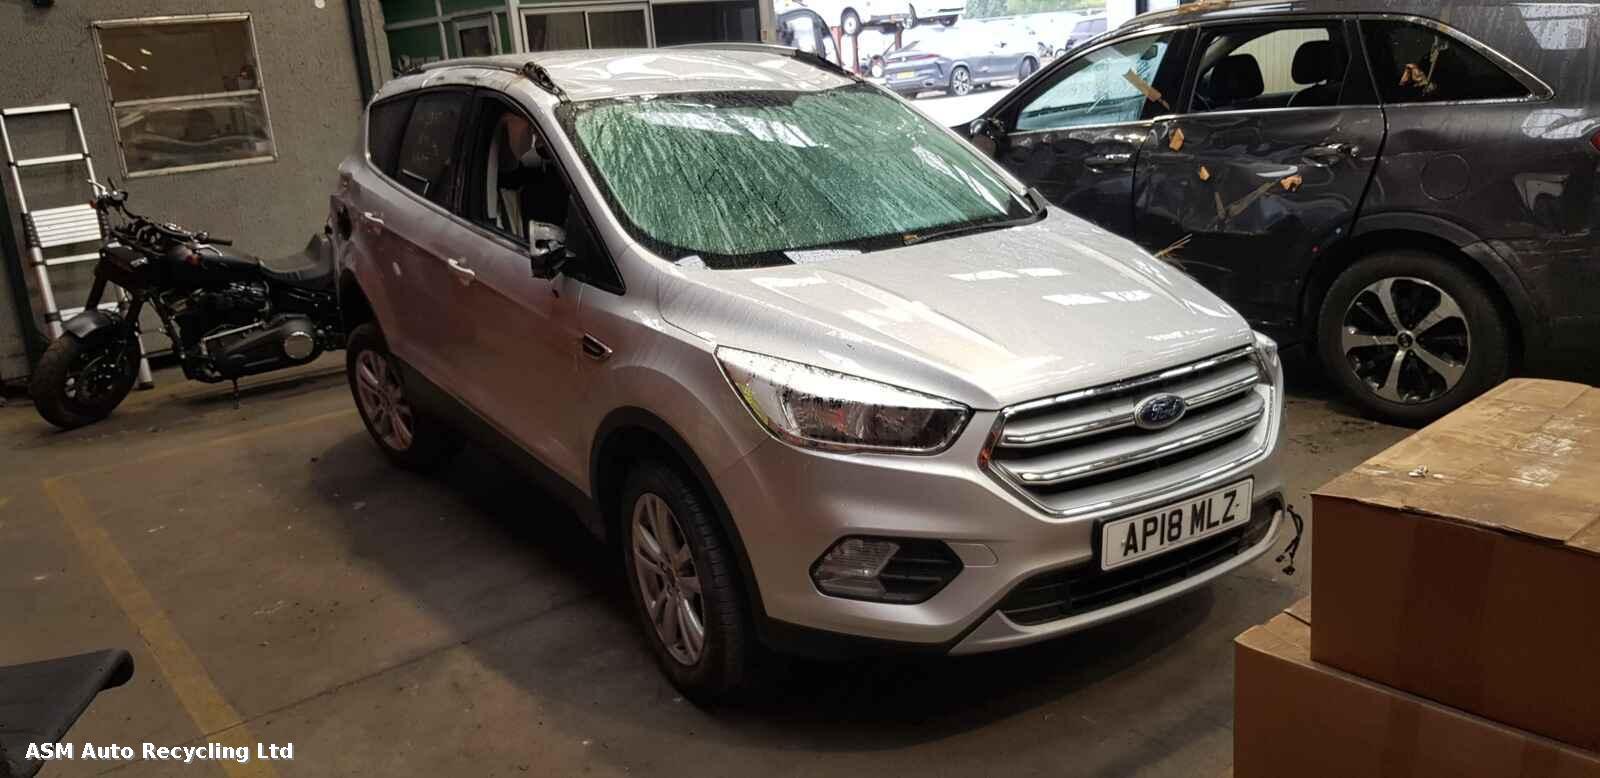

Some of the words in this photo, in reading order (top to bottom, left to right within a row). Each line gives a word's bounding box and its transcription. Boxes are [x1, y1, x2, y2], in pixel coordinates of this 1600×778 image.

[1149, 398, 1180, 421] Ford
[1123, 508, 1183, 557] AP18
[1189, 489, 1237, 536] MLZ
